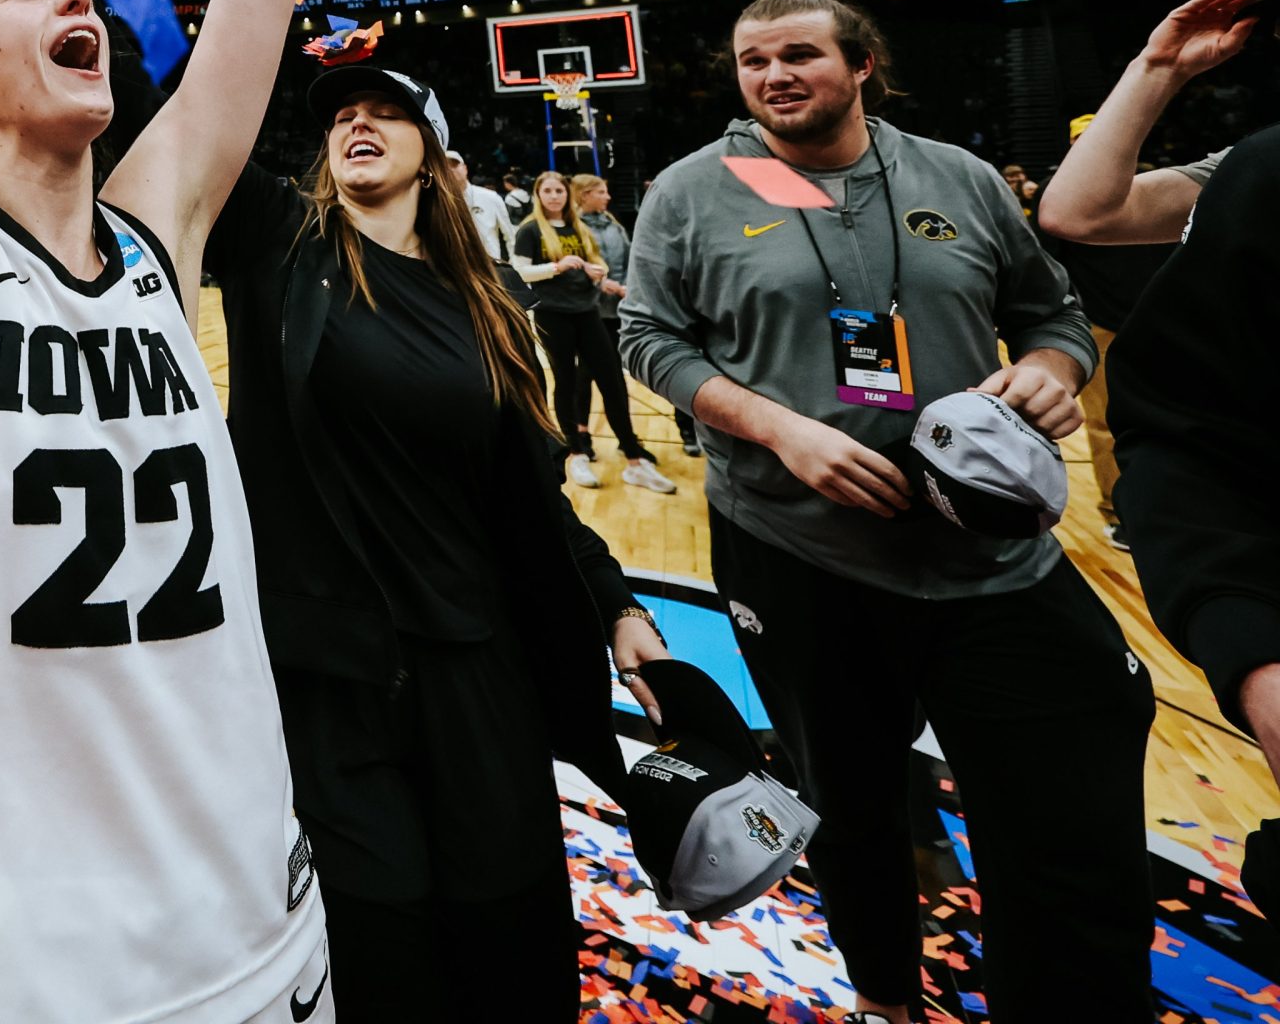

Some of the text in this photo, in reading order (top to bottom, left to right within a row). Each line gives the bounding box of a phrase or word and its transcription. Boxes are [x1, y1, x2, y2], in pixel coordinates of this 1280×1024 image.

[850, 346, 878, 356] SEATTLE
[864, 392, 888, 403] TEAM
[11, 443, 225, 649] 22
[649, 767, 674, 782] 2023
[745, 806, 782, 851] FINAL FOUR
